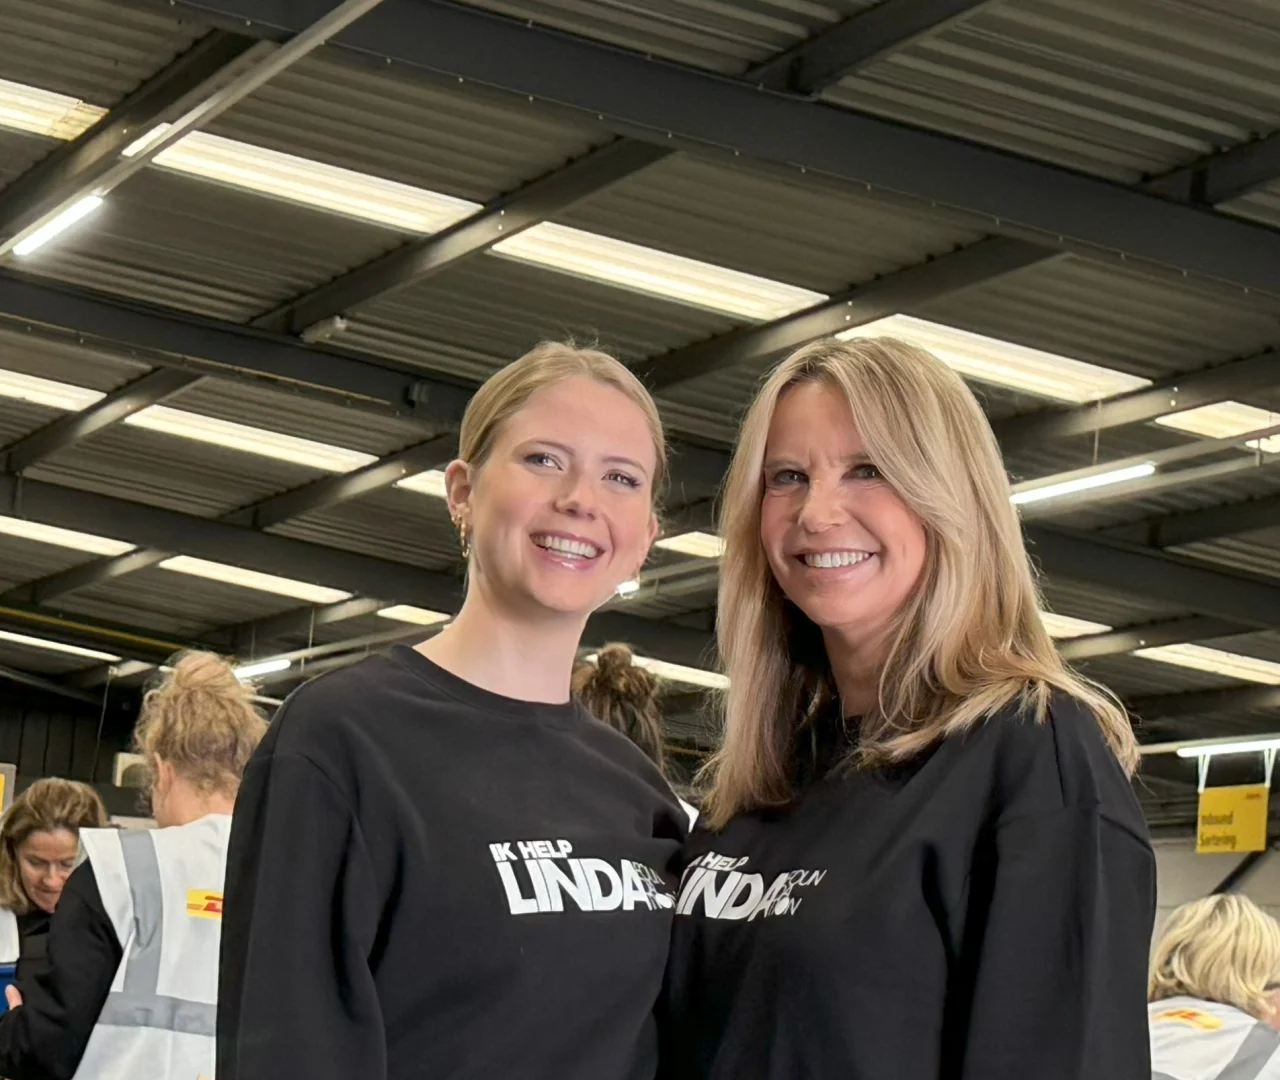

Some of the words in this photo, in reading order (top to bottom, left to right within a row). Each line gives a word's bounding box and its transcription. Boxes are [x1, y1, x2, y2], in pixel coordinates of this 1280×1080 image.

[489, 843, 518, 862] IK
[517, 840, 573, 859] HELP
[700, 851, 749, 871] HELP
[496, 858, 650, 915] LINDA
[676, 867, 789, 922] INDA
